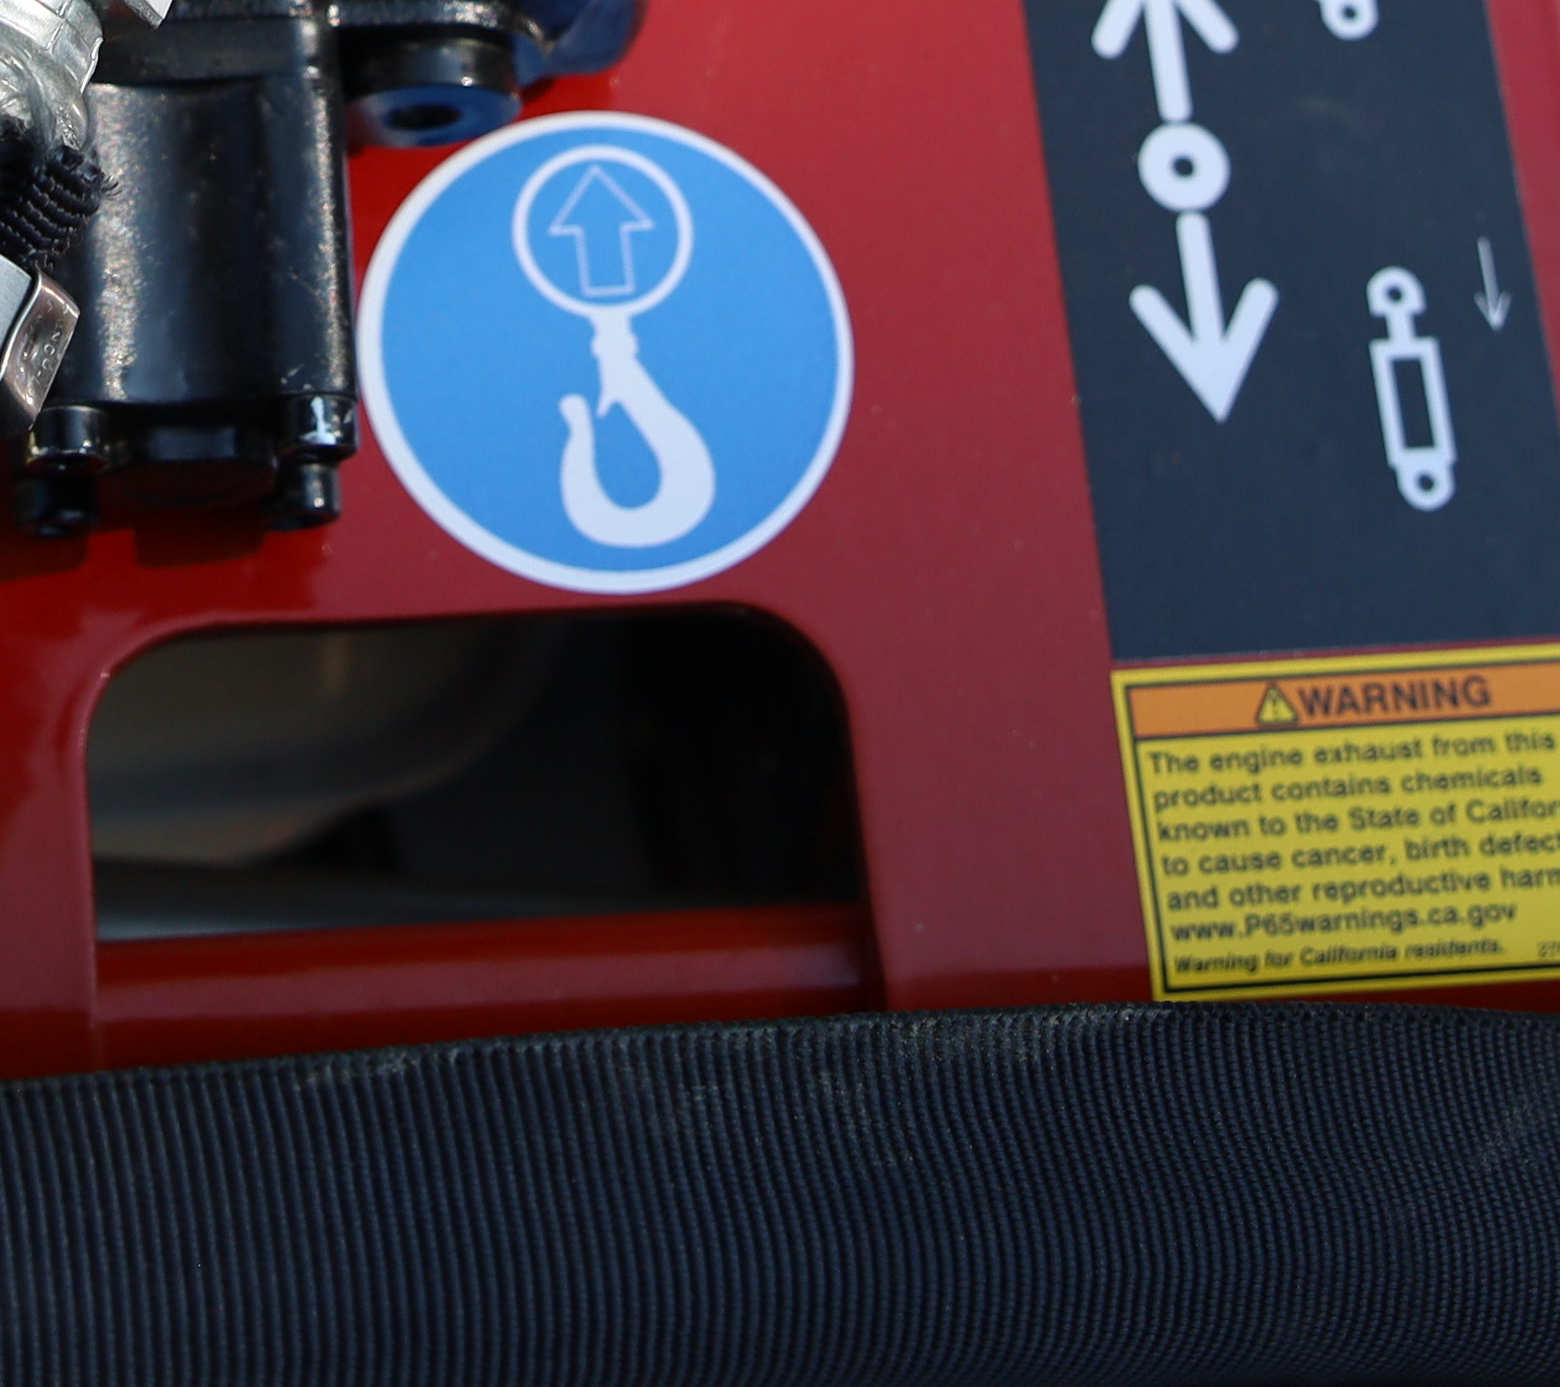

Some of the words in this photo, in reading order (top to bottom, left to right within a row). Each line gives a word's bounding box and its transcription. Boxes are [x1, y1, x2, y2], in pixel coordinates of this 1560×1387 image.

[1298, 676, 1492, 718] WARNING
[1149, 751, 1199, 775] The
[1210, 748, 1303, 773] engine
[1314, 737, 1423, 765] exhaust
[1433, 735, 1497, 758] from
[1505, 731, 1557, 754] this
[1154, 783, 1263, 813] product
[1272, 776, 1391, 803] contains
[1402, 765, 1542, 793] chemicals
[1158, 815, 1248, 842] known
[1259, 814, 1286, 835] to
[1295, 810, 1338, 834] the
[1348, 803, 1420, 830] State
[1430, 800, 1457, 825] of
[1161, 852, 1188, 877] to
[1199, 850, 1281, 875] cause
[1292, 843, 1395, 871] cancer,
[1405, 835, 1470, 862] birth
[1167, 886, 1220, 912] and
[1229, 881, 1301, 908] other
[1313, 870, 1491, 905] reproductive
[1170, 901, 1519, 942] www.P65warnings.ca.gov
[1173, 951, 1259, 975] Warning
[1264, 947, 1293, 970] for
[1301, 943, 1398, 968] California
[1406, 938, 1505, 961] residents.
